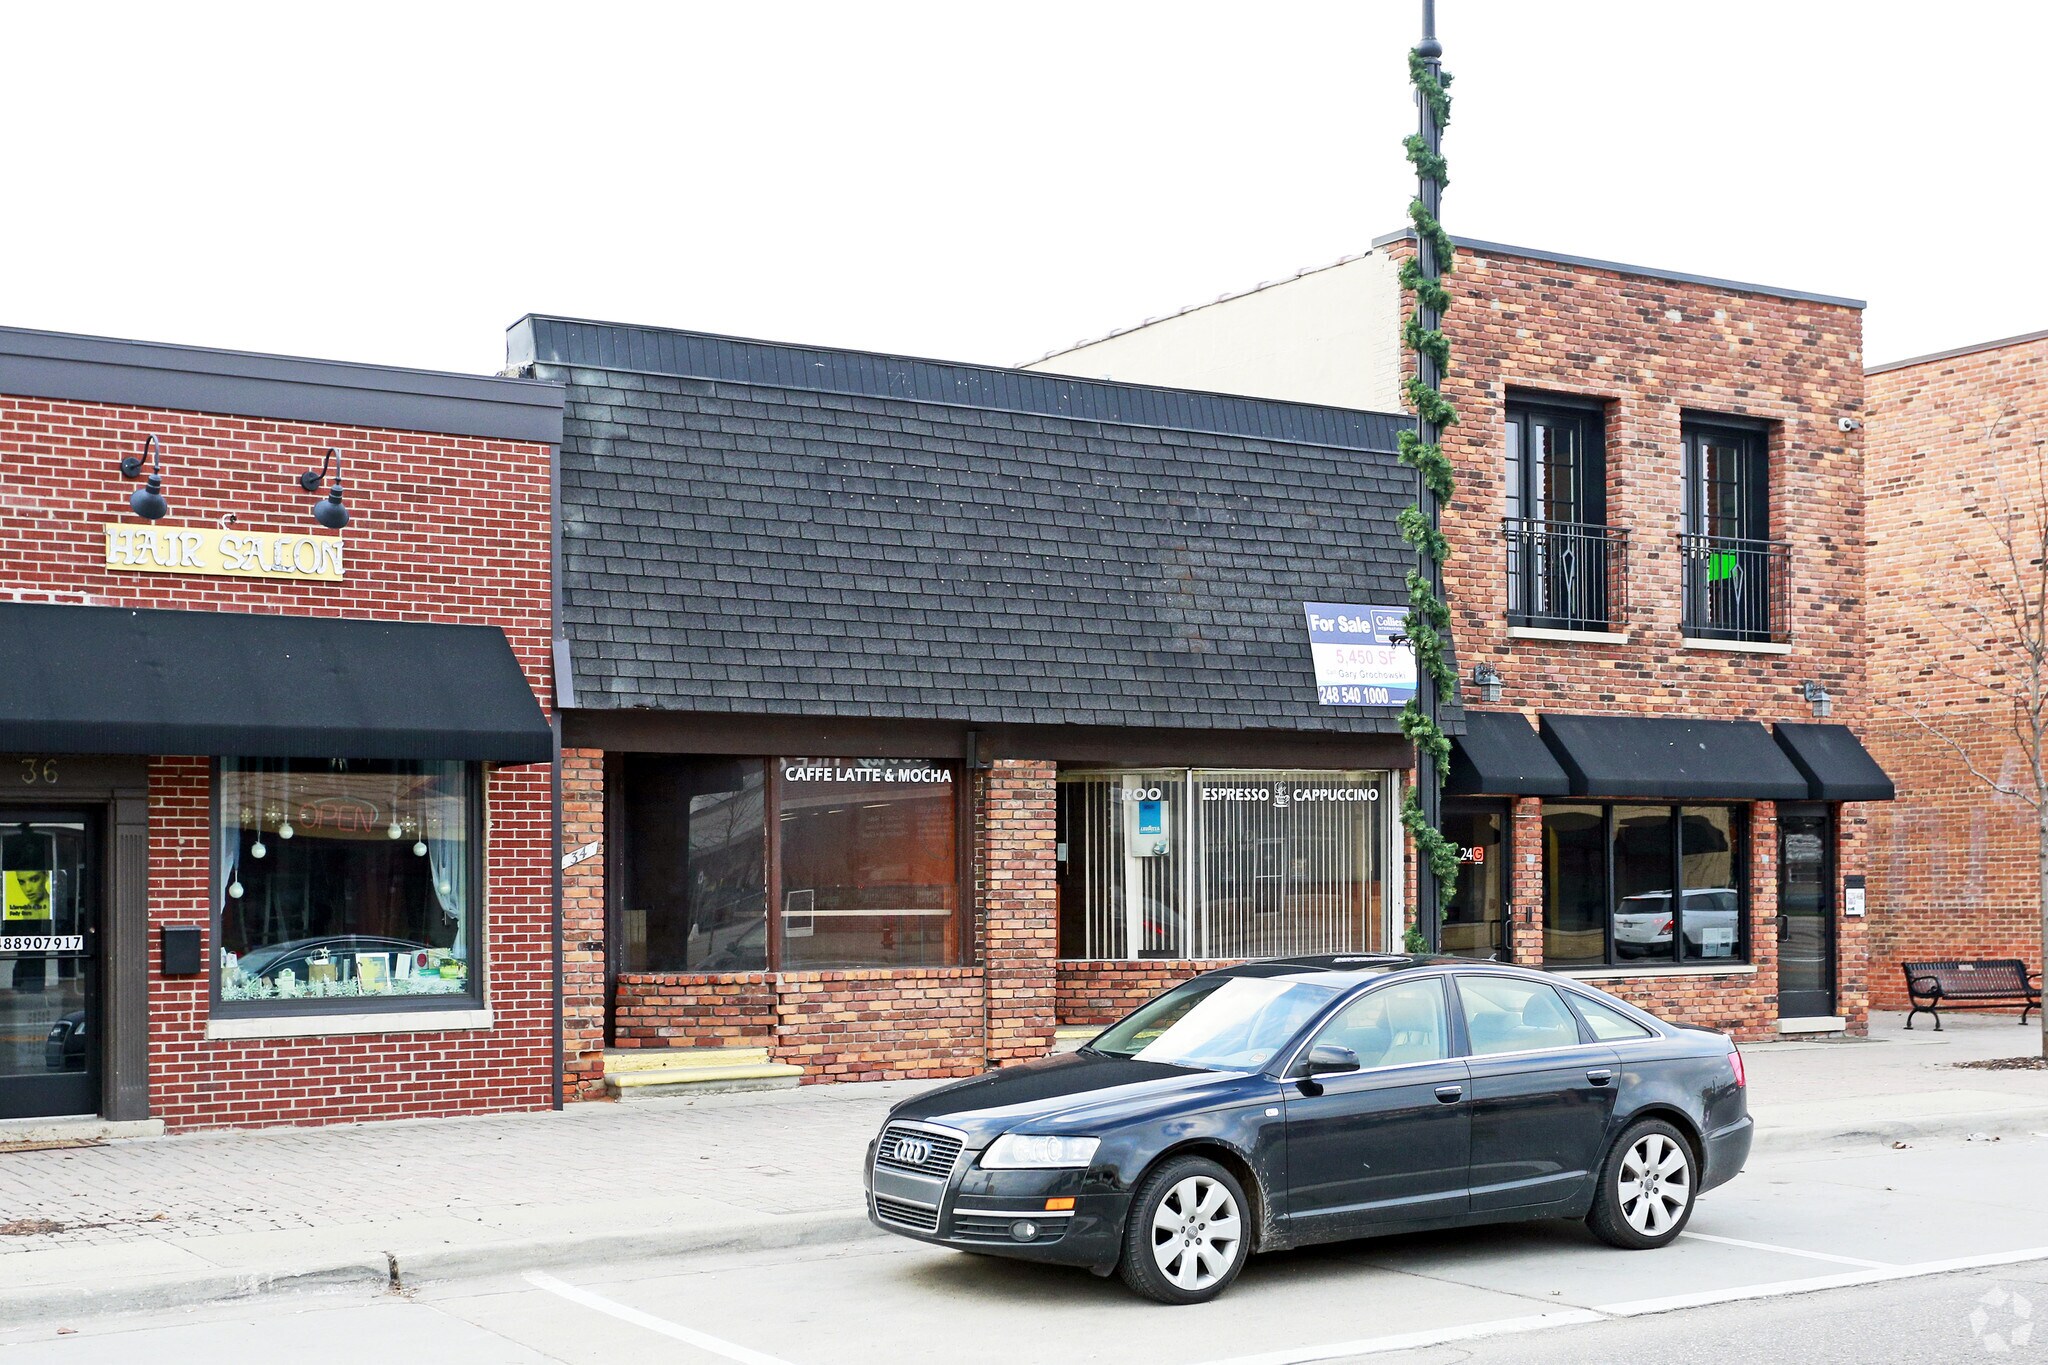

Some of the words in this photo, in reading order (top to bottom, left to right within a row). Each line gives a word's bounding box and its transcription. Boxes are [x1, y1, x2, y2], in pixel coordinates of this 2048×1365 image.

[106, 527, 207, 568] HAIR
[218, 533, 345, 576] SALON
[1309, 614, 1335, 632] For
[1337, 615, 1371, 634] Sale
[1336, 649, 1374, 667] 5,450
[1378, 651, 1397, 665] SF
[1338, 669, 1357, 680] Gary
[1359, 669, 1406, 679] Grochowski
[1320, 686, 1340, 703] 248
[1341, 686, 1361, 704] 540
[1362, 687, 1389, 705] 1000
[21, 758, 59, 784] 36
[785, 767, 832, 782] CAFFE
[835, 768, 881, 783] LATTE
[884, 768, 895, 783] &
[897, 769, 952, 784] MOCHA
[1202, 787, 1270, 801] ESPRESSO
[1293, 788, 1379, 802] CAPPUCCINO
[300, 804, 374, 832] OPEN
[571, 847, 587, 864] 34
[0, 937, 81, 950] 88907917
